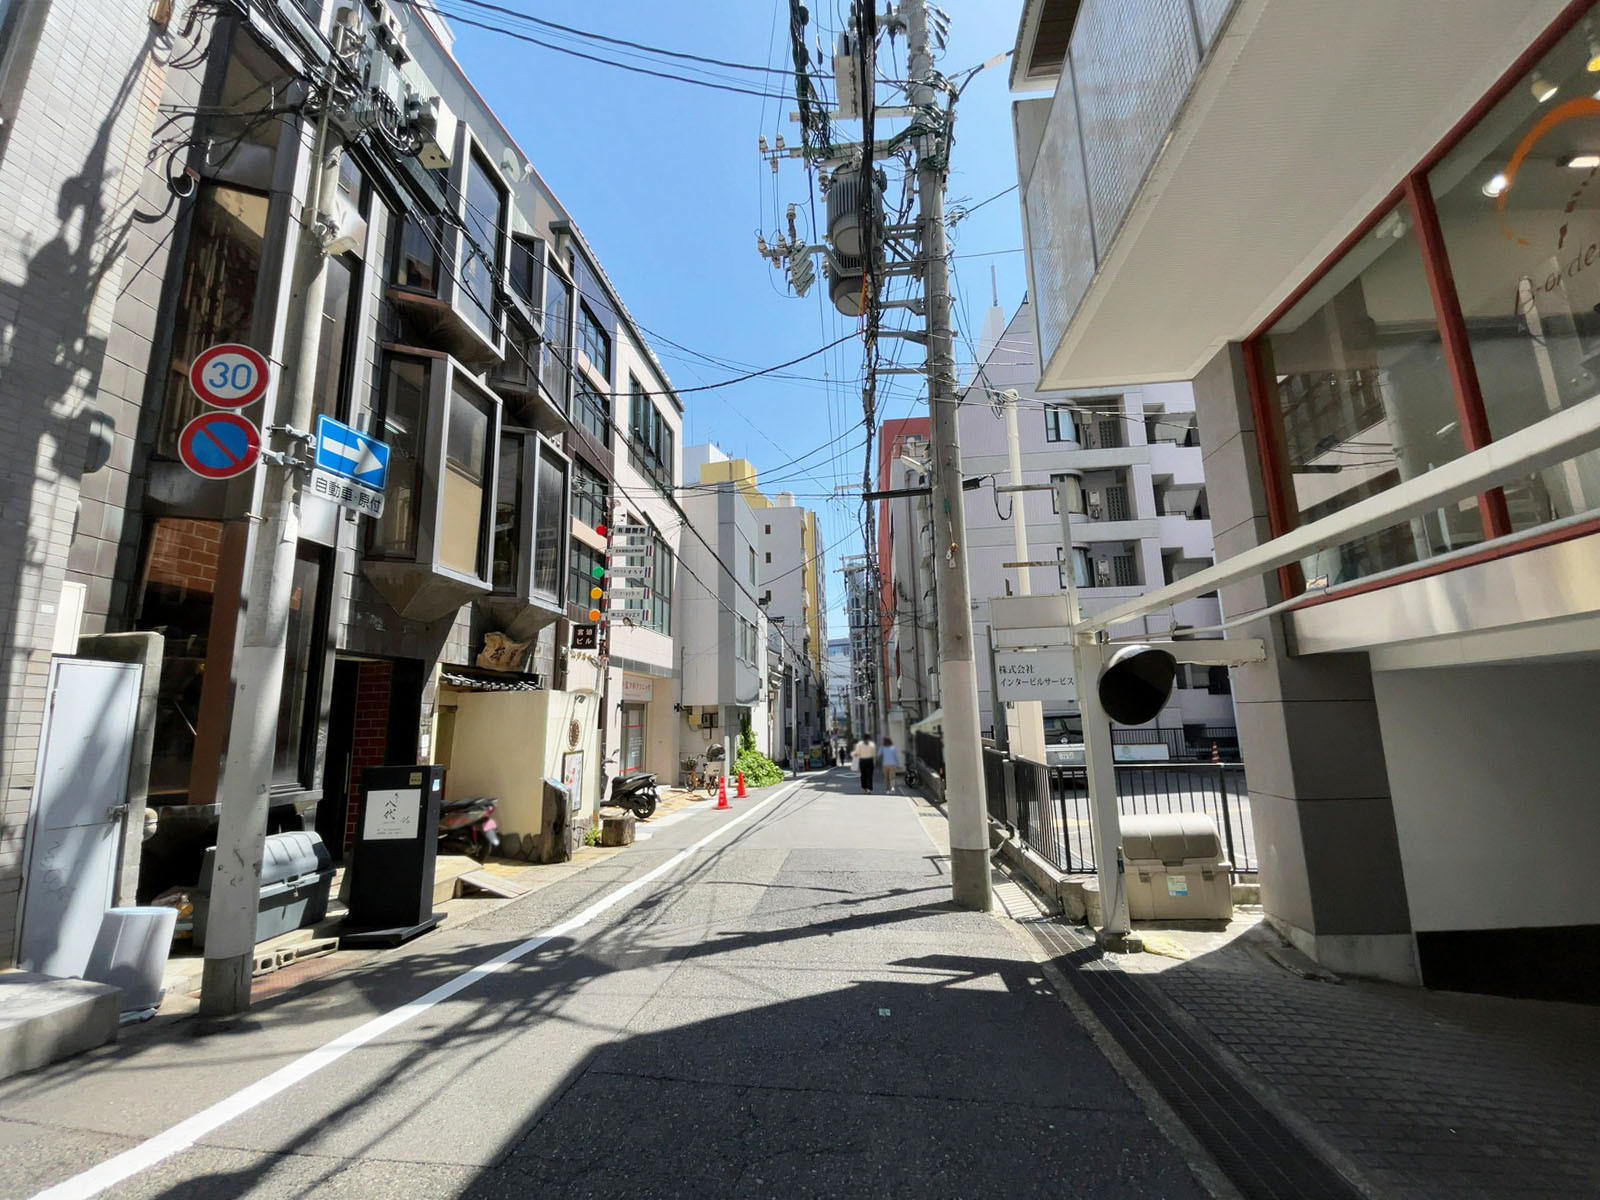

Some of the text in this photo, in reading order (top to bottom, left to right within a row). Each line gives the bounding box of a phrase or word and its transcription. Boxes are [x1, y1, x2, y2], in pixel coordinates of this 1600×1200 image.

[208, 361, 252, 390] 30
[315, 477, 381, 513] 自動車・原付
[576, 637, 593, 645] ビル
[999, 664, 1034, 675] 株式会社
[1001, 677, 1074, 687] インタービルサービス
